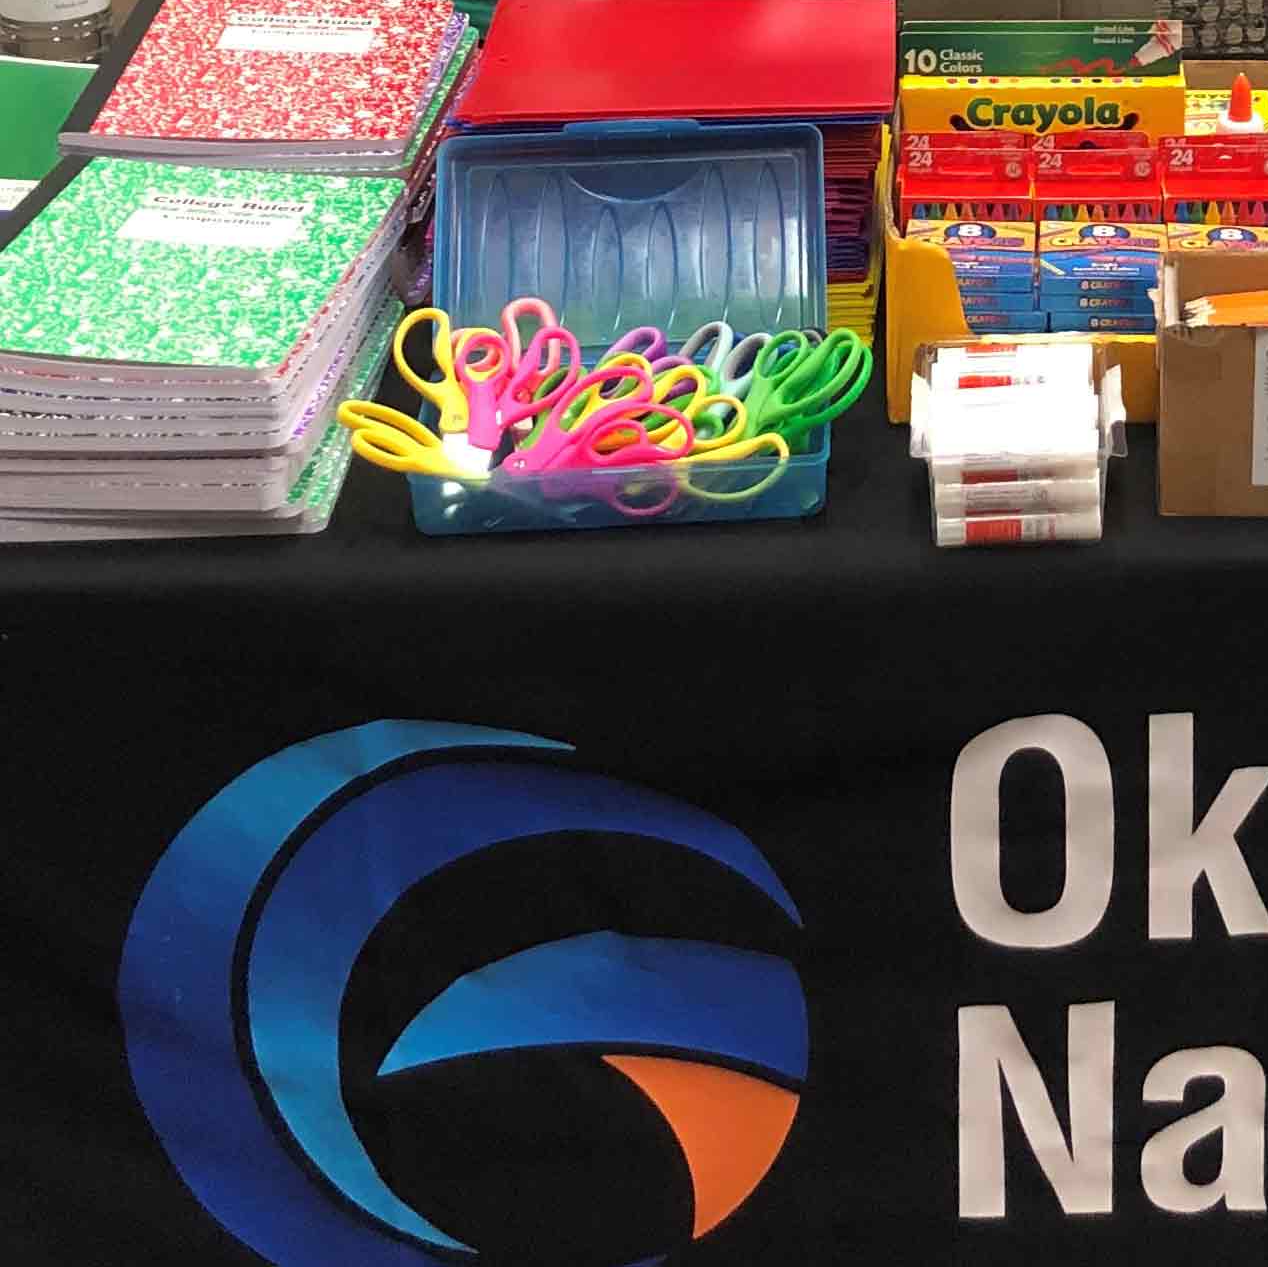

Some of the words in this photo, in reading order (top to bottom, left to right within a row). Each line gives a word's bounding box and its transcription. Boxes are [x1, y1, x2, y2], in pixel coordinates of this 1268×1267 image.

[903, 48, 937, 74] 10
[939, 48, 985, 62] Classic
[939, 62, 983, 75] Colors
[966, 96, 1121, 133] Crayola
[908, 151, 933, 167] 24
[1039, 152, 1063, 168] 24
[1169, 149, 1194, 165] 24
[153, 195, 234, 209] College
[240, 201, 305, 213] Ruled
